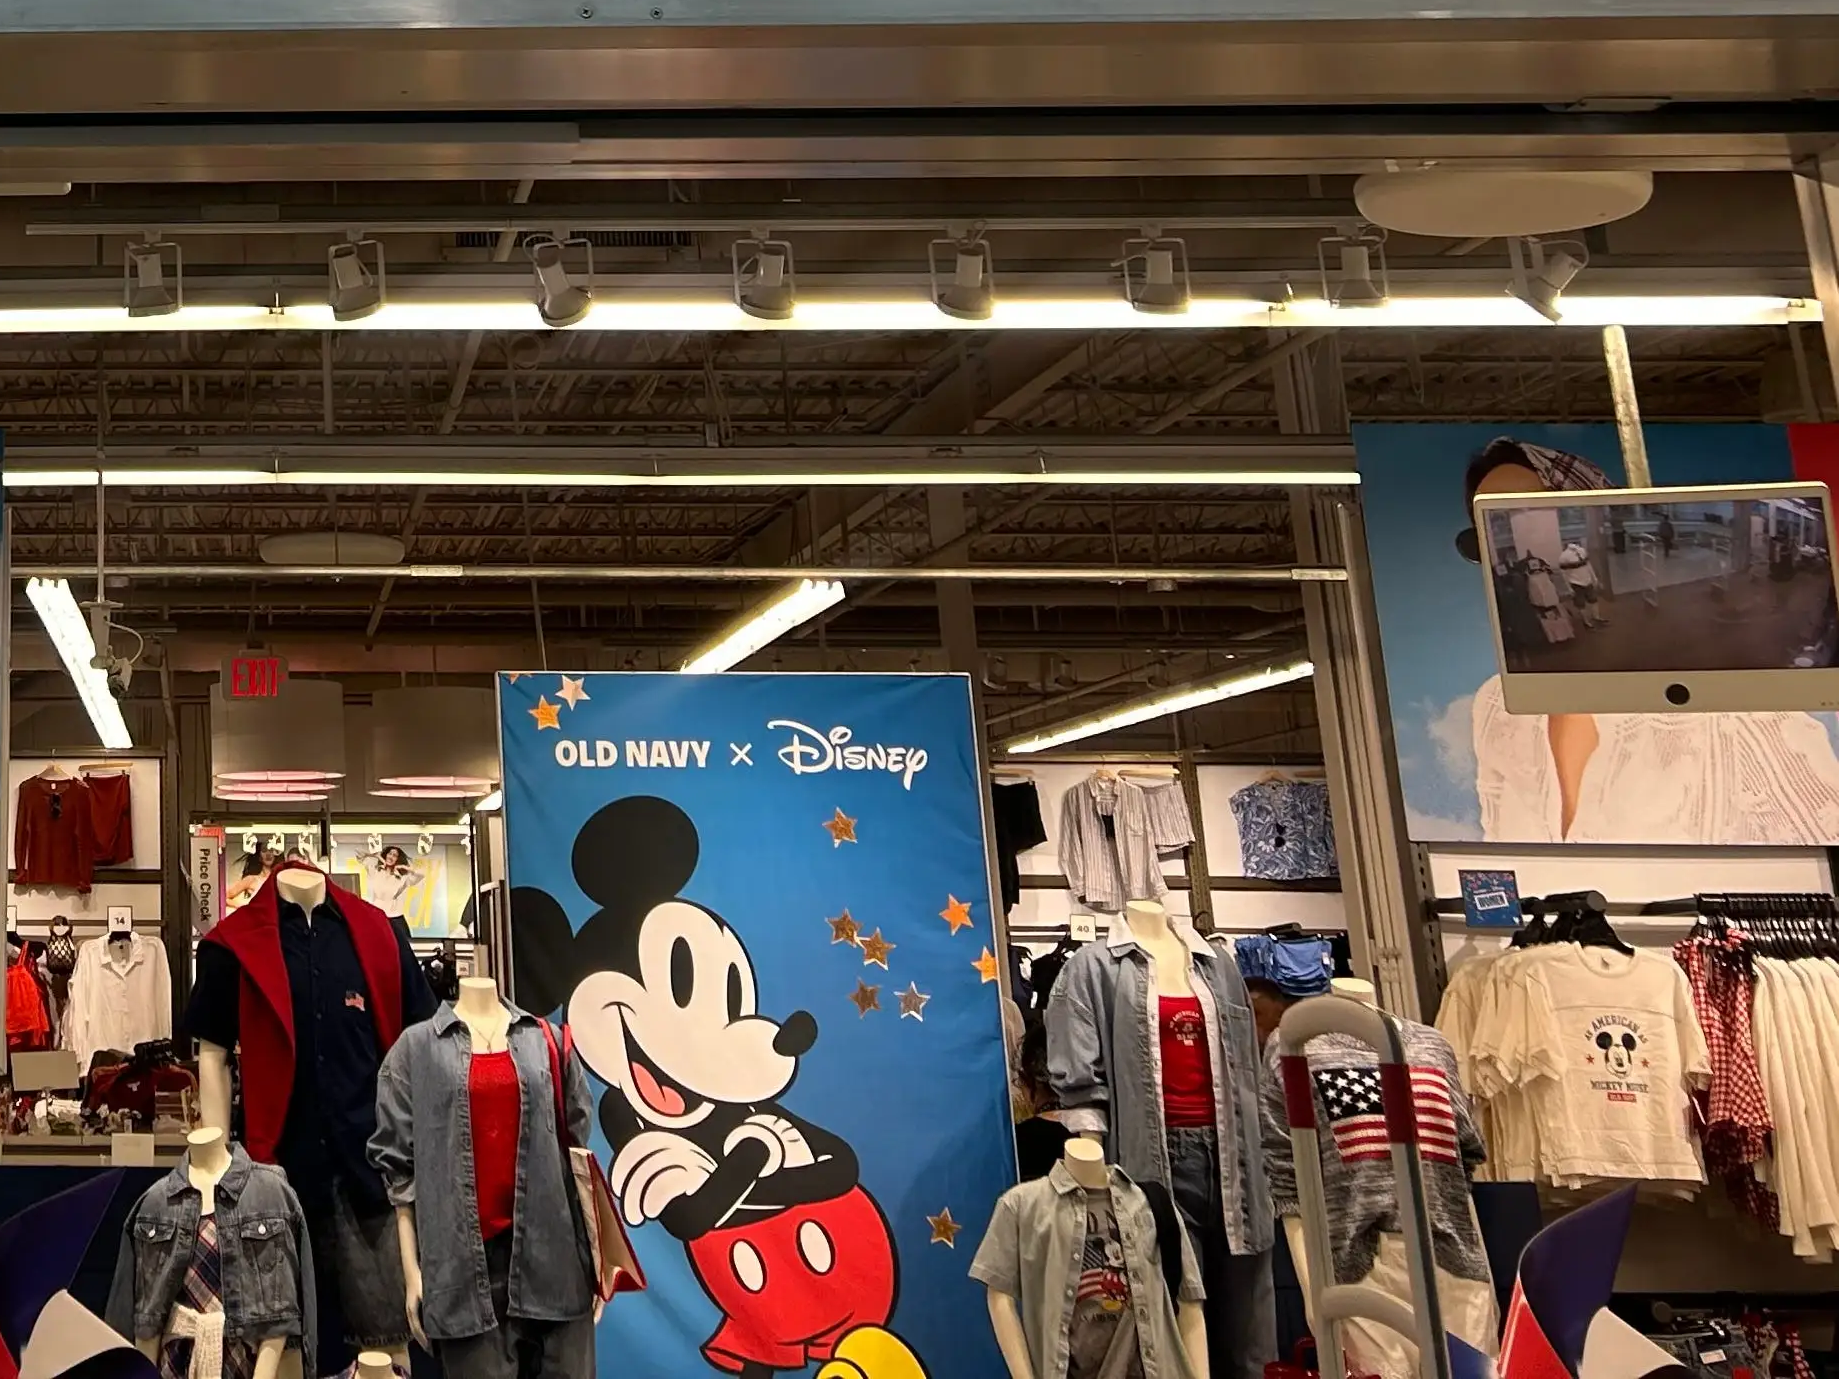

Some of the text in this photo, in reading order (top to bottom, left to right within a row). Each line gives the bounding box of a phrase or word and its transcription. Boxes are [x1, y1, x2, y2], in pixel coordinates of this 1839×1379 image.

[231, 657, 280, 697] EXIT
[555, 740, 618, 767] OLD
[625, 740, 711, 768] NAVY
[199, 848, 212, 921] Price Check
